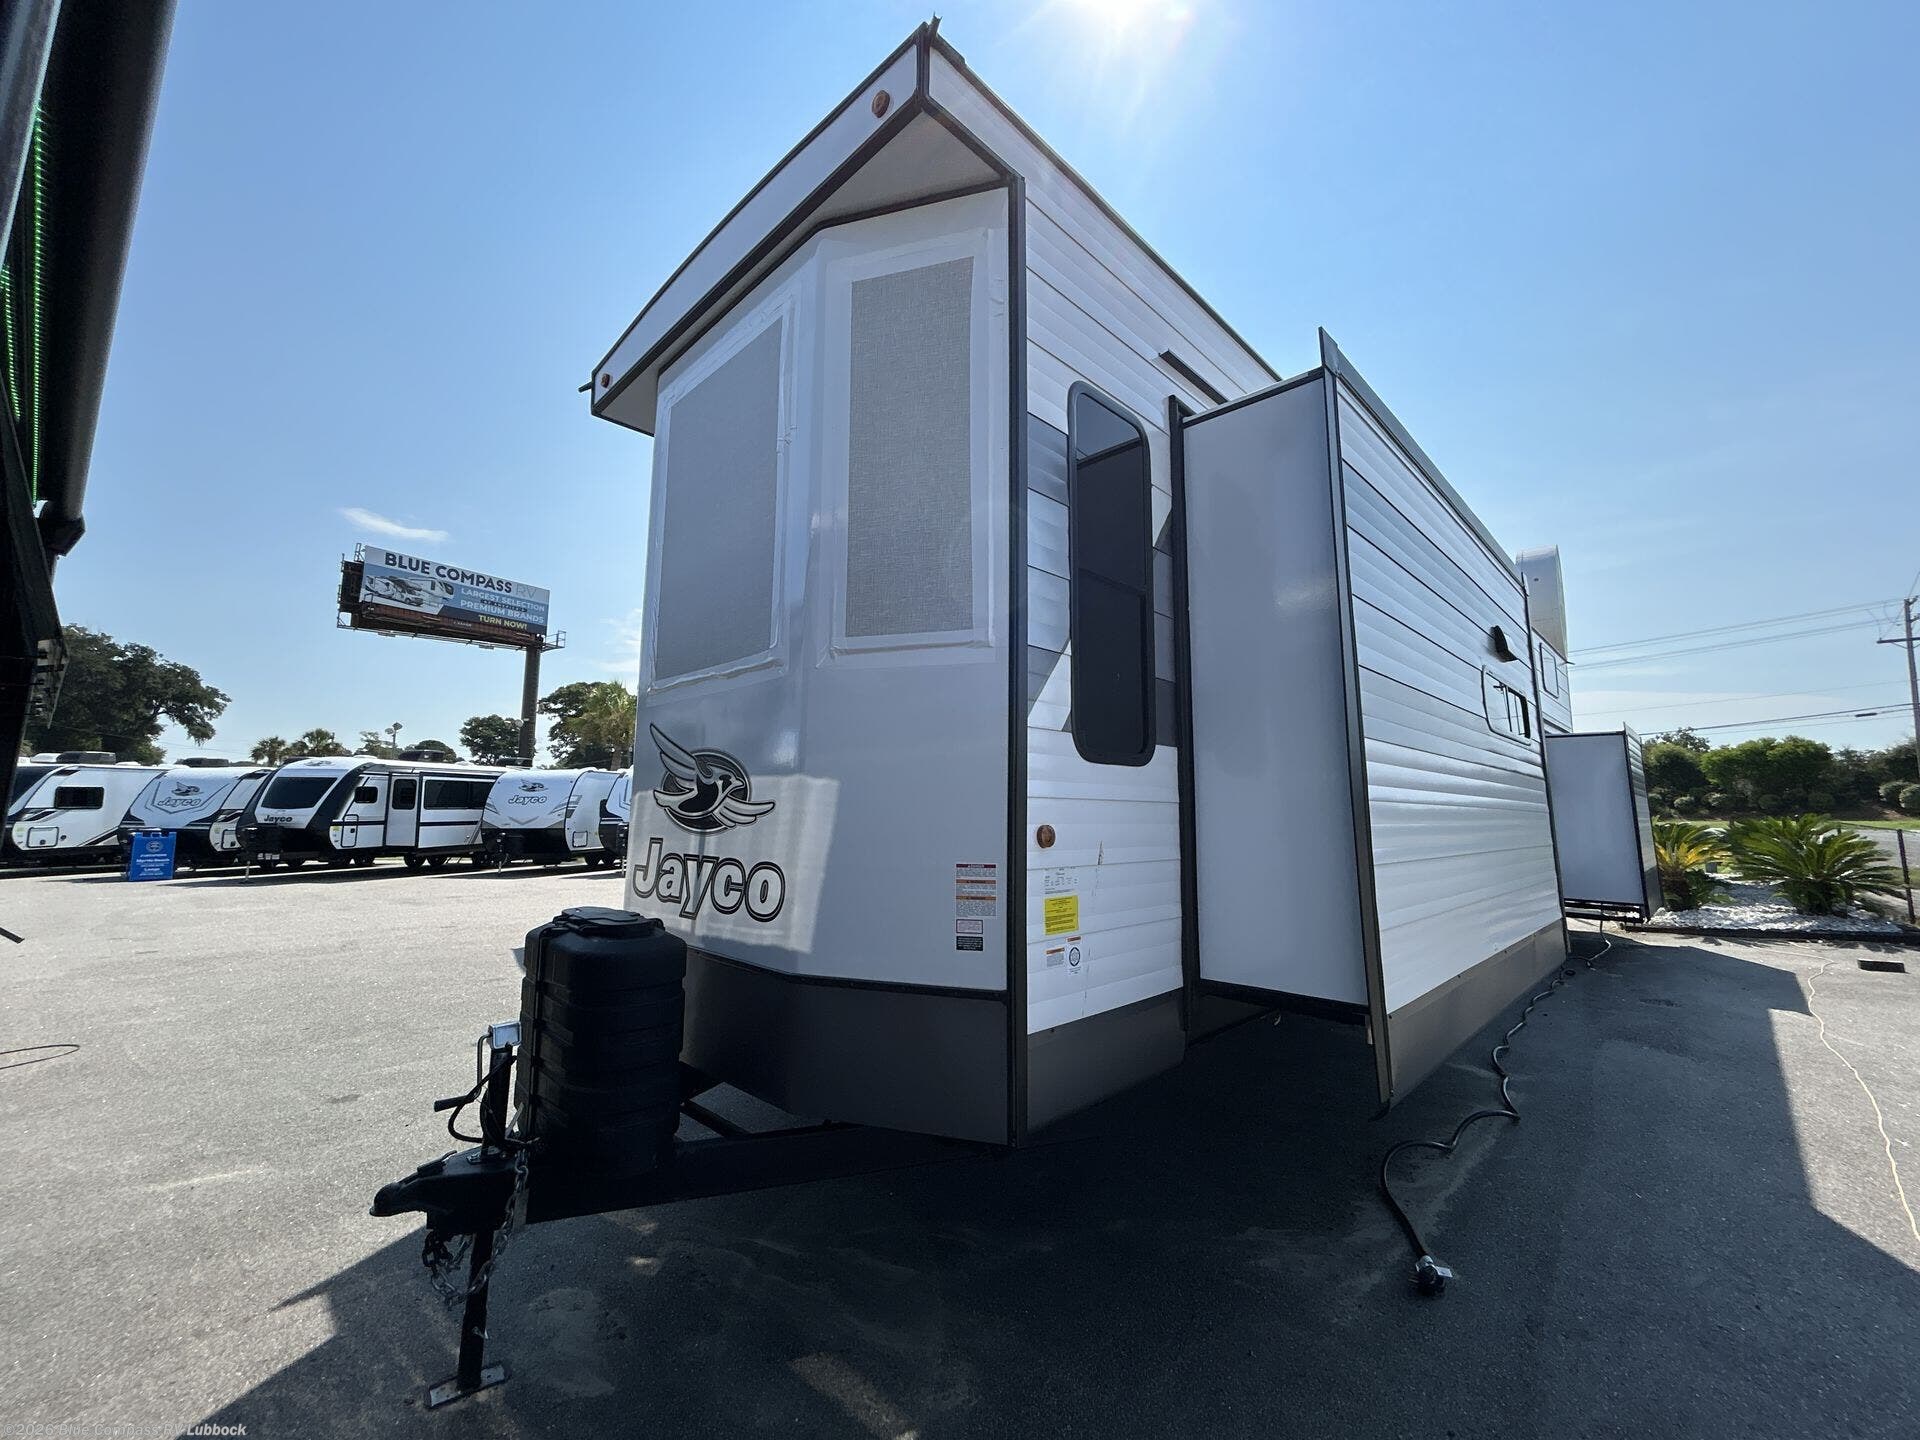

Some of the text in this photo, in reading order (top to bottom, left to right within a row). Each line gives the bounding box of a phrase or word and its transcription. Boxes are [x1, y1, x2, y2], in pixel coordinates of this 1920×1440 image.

[384, 552, 537, 599] BLUE COMPASS RV
[461, 588, 500, 602] LARGEST
[502, 598, 545, 612] SELECTION
[460, 600, 505, 615] PREMIUM
[507, 610, 545, 624] BRANDS
[478, 614, 502, 625] TURN
[503, 619, 528, 630] NOW!
[157, 798, 201, 808] Jayco
[508, 794, 547, 805] Jayco
[263, 814, 292, 824] Jayco
[632, 837, 786, 923] Jayco
